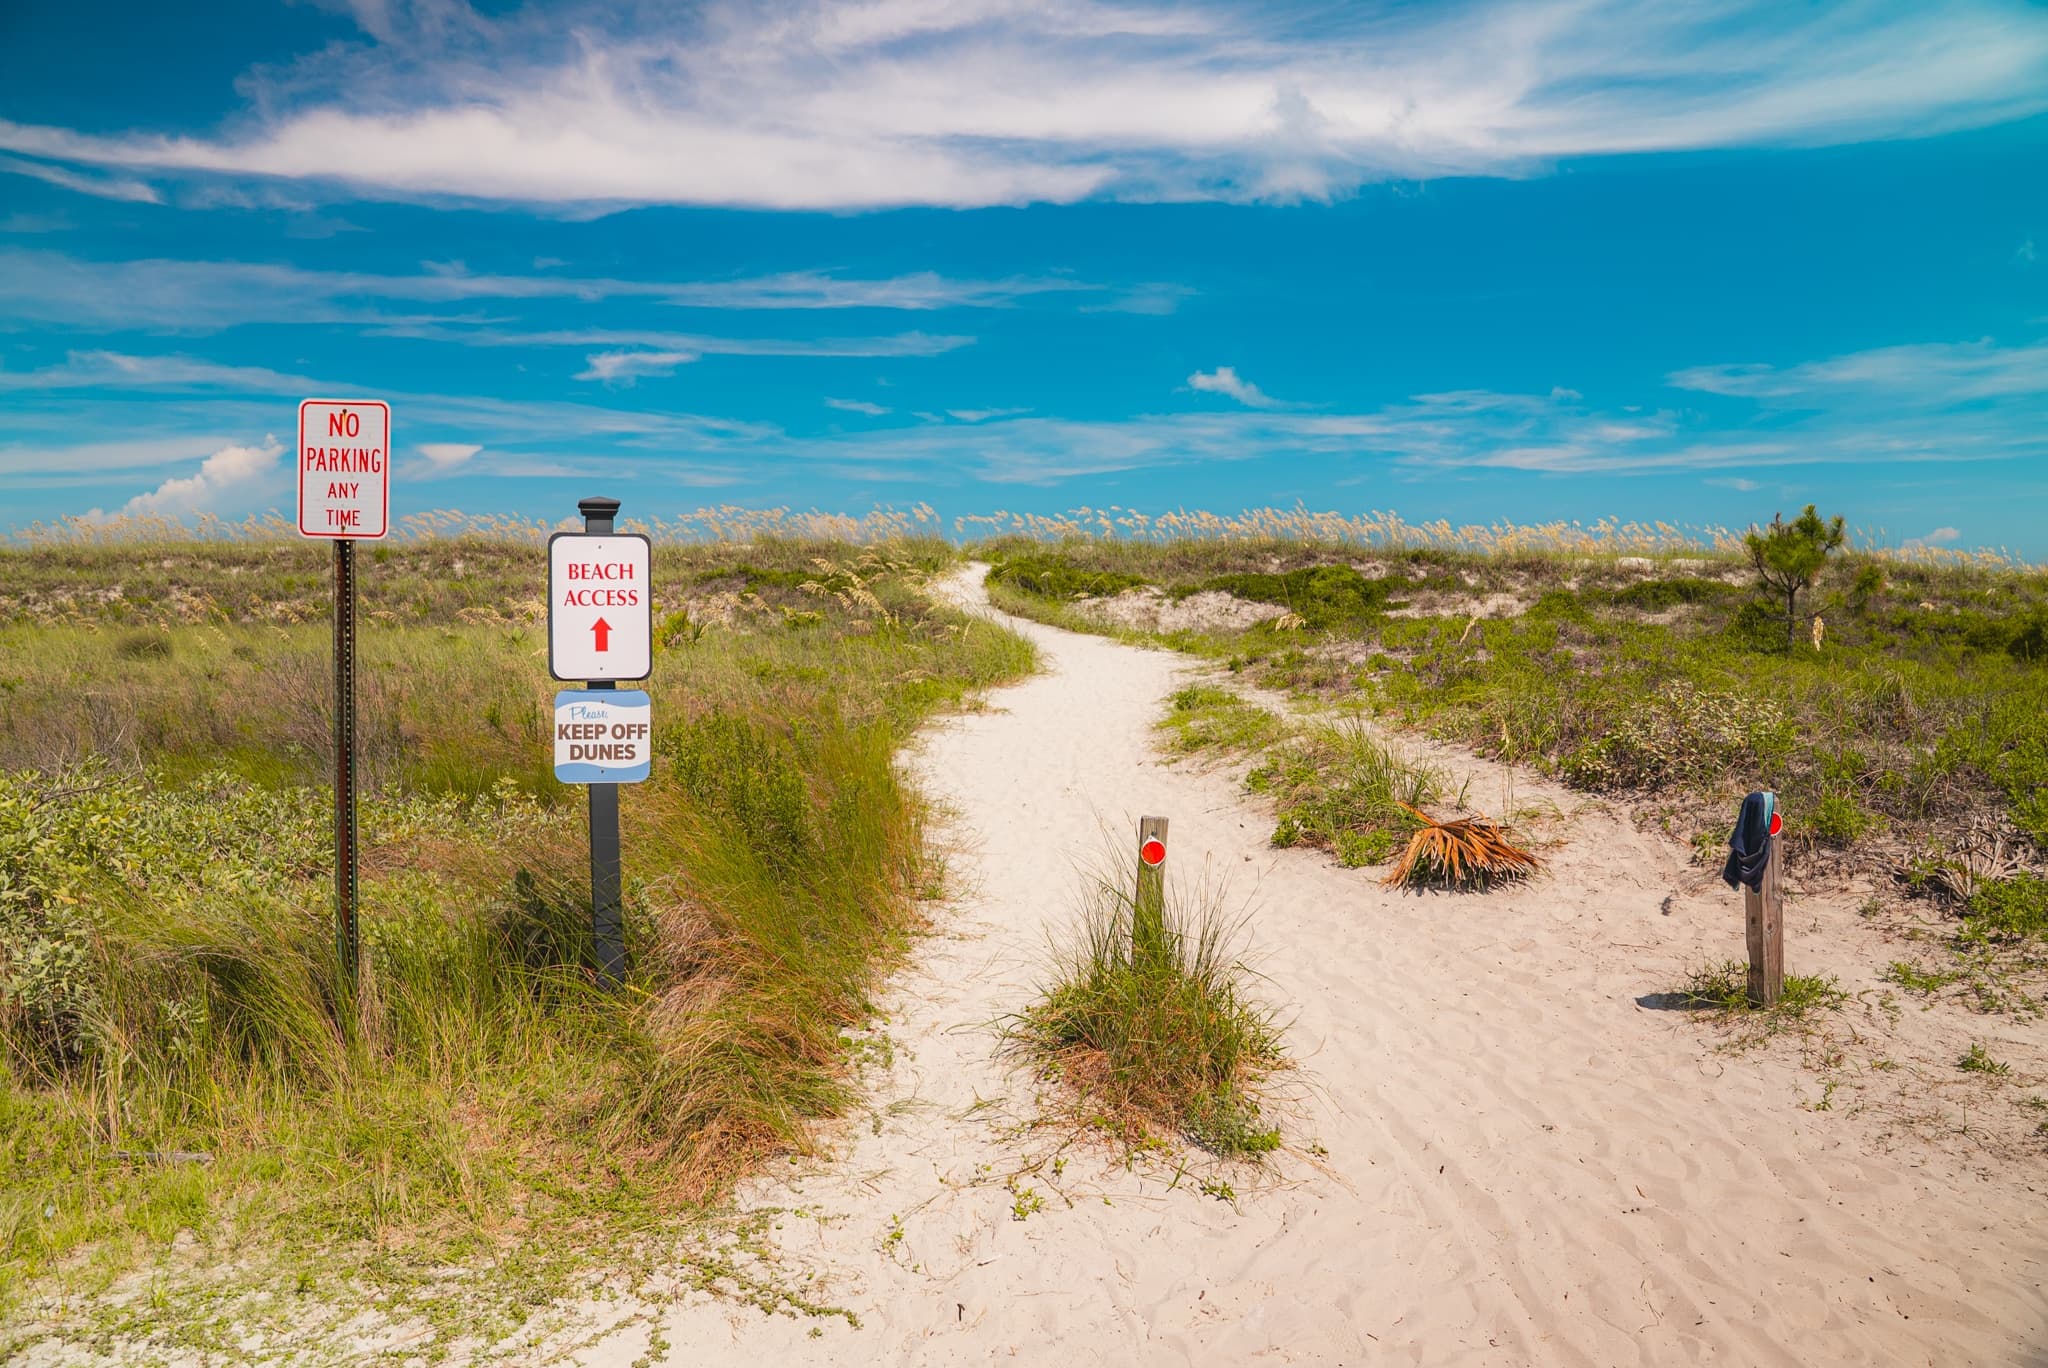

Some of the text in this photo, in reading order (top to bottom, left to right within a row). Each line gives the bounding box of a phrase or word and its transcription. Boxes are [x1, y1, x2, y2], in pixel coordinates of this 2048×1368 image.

[329, 412, 359, 437] NO
[306, 447, 381, 473] PARKING
[327, 482, 359, 499] ANY
[326, 509, 360, 526] TIME
[568, 563, 633, 580] BEACH
[564, 589, 638, 606] ACCESS
[558, 723, 648, 740] KEEP OFF
[569, 744, 636, 761] DUNES
